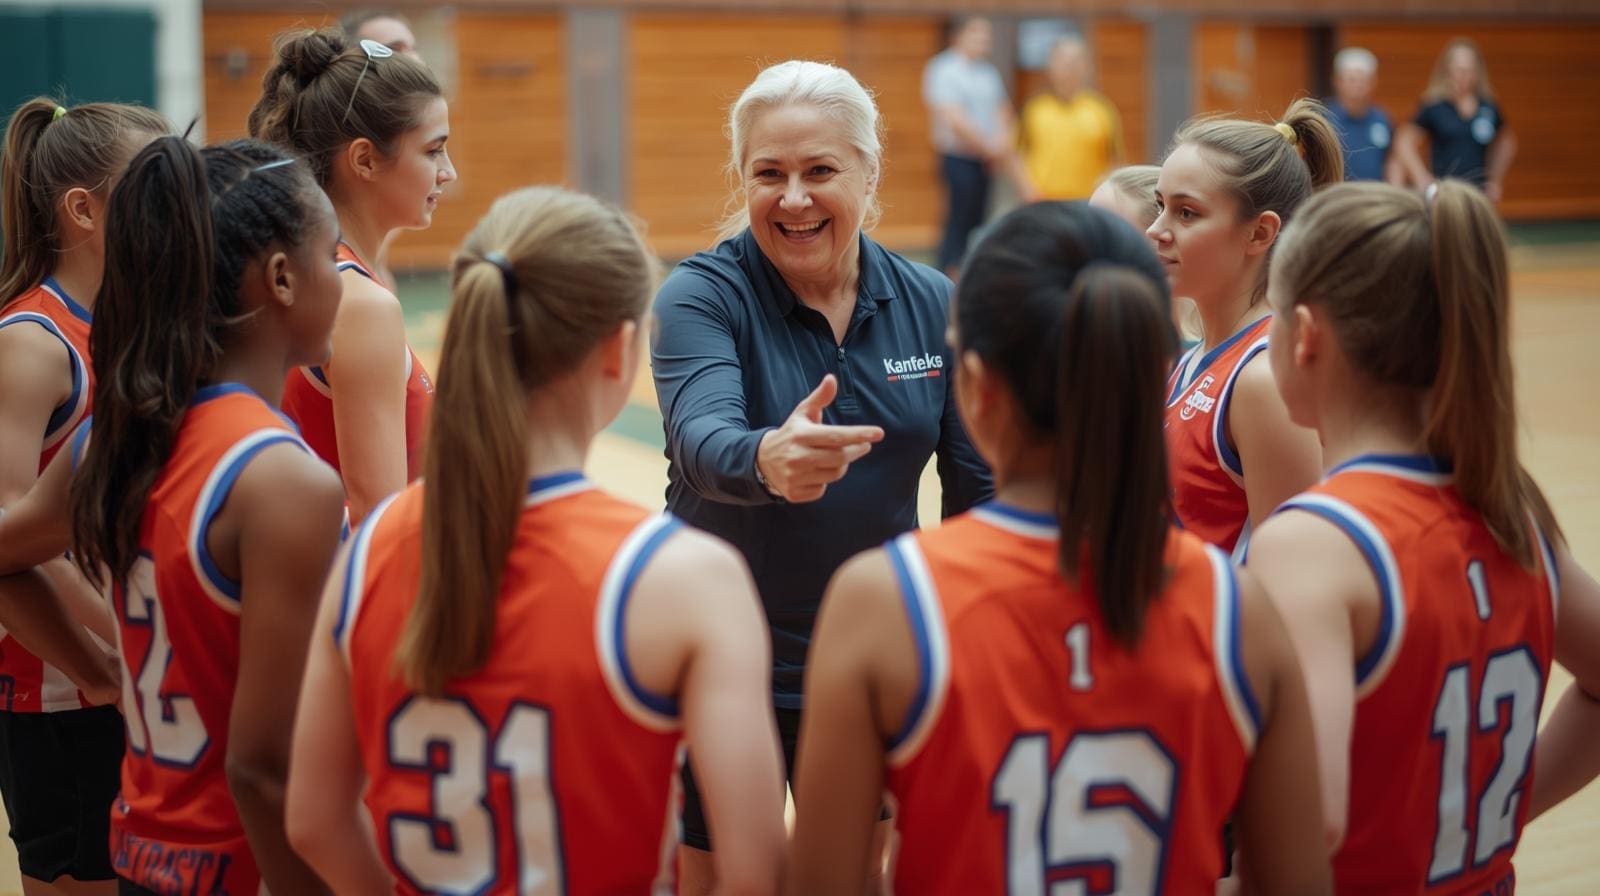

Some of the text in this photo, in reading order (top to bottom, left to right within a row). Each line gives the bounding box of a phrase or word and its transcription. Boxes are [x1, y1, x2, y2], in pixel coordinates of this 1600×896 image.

[883, 352, 943, 374] Kanfeks
[1467, 559, 1492, 621] 1
[1065, 622, 1094, 690] 1
[1425, 643, 1541, 877] 12
[388, 693, 570, 896] 31
